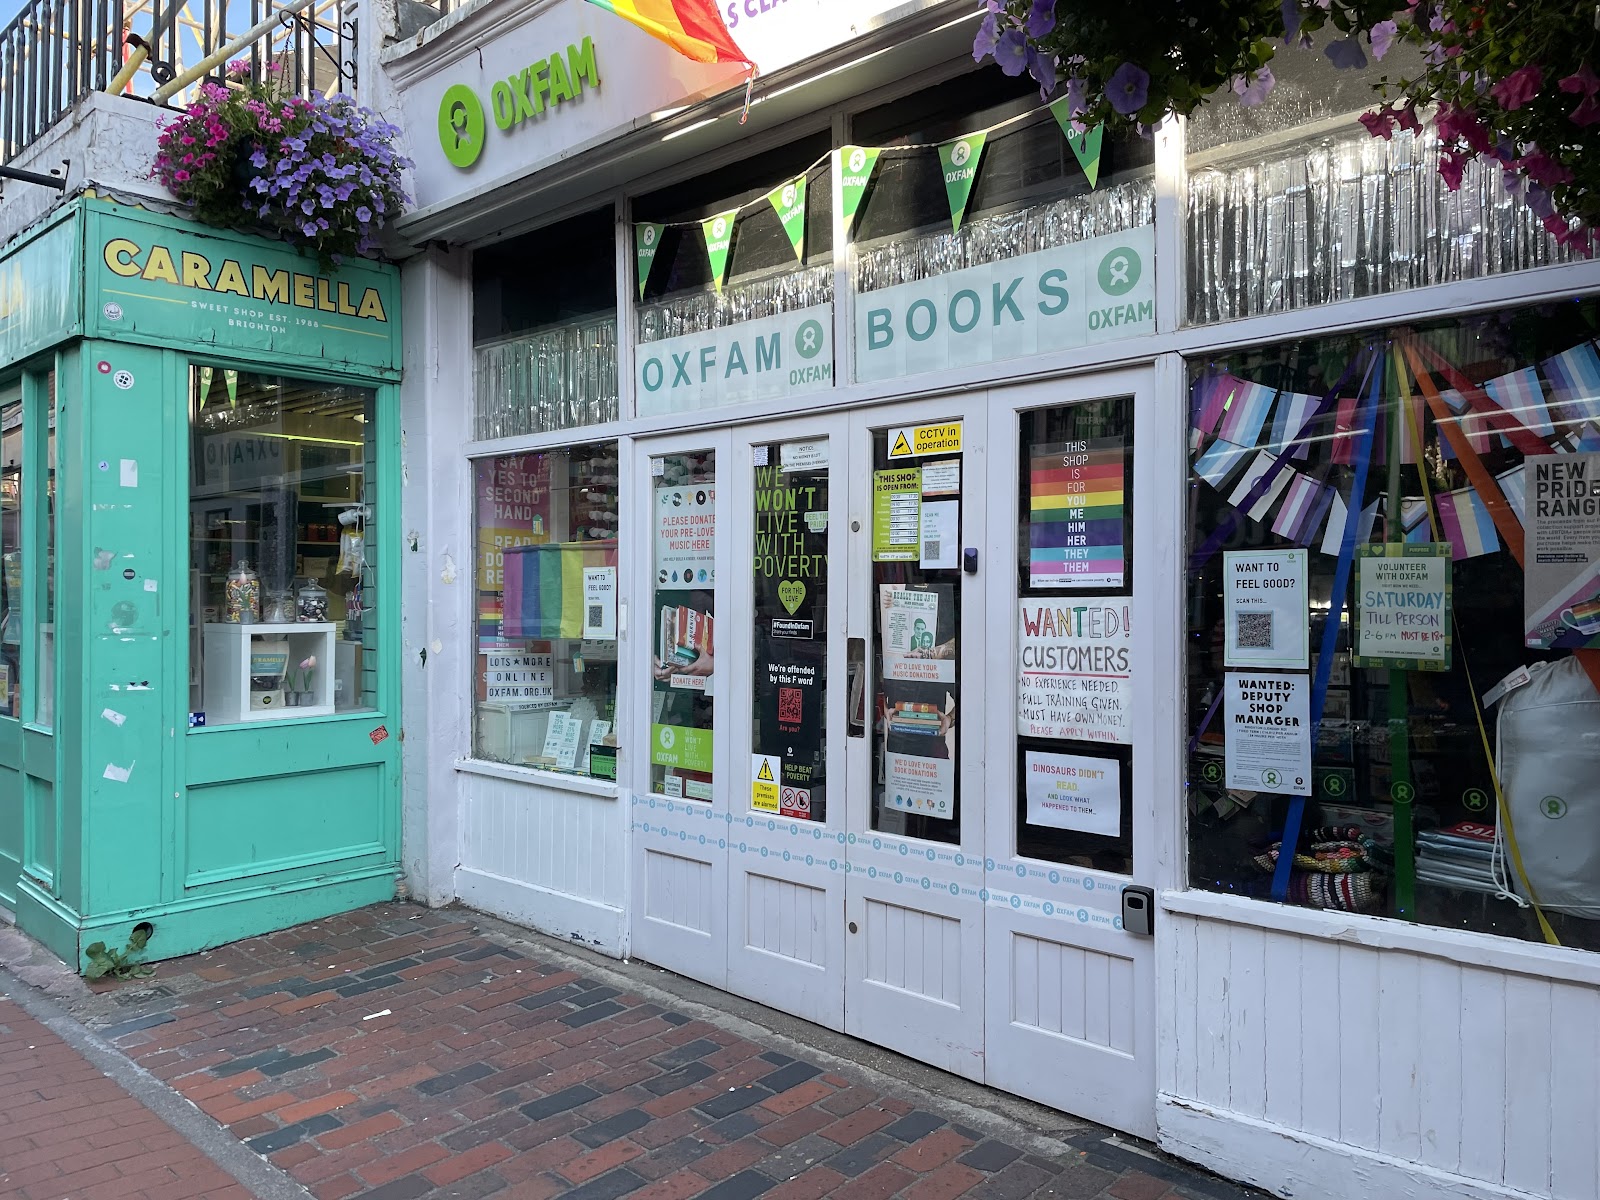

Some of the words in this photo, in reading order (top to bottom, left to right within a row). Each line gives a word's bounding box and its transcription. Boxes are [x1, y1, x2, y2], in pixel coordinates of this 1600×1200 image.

[491, 36, 598, 131] OXFAM
[945, 166, 975, 184] OXFAM
[842, 174, 867, 188] OXFAM
[781, 202, 804, 225] OXFAM
[708, 239, 730, 253] OXFAM
[638, 248, 656, 258] OXFAM
[103, 237, 388, 323] CARAMELLA
[191, 300, 229, 313] SWEET
[233, 307, 264, 319] SHOP
[269, 313, 291, 323] EST.
[295, 317, 319, 328] 1988
[867, 268, 1070, 352] BOOKS
[1088, 299, 1153, 332] OXFAM
[228, 318, 286, 334] BRIGHTON
[641, 331, 782, 393] OXFAM
[788, 362, 832, 387] OXFAM
[919, 428, 945, 439] CCTV
[947, 427, 956, 437] in
[916, 438, 959, 452] operation
[1065, 440, 1087, 453] THIS
[499, 456, 526, 470] SAY
[1063, 454, 1089, 467] SHOP
[756, 465, 785, 488] WE
[1071, 469, 1080, 479] IS
[1536, 462, 1586, 481] NEW
[488, 469, 516, 486] YES
[521, 472, 538, 488] TO
[879, 474, 896, 483] THIS
[896, 472, 916, 482] SHOP
[899, 482, 919, 490] FROM:
[1067, 482, 1086, 493] FOR
[485, 486, 540, 505] SECOND
[755, 487, 816, 512] WON'T
[1067, 495, 1087, 506] YOU
[494, 504, 532, 521] HAND
[1069, 508, 1084, 519] ME
[1536, 499, 1600, 517] RANG
[663, 516, 689, 526] PLEASE
[690, 514, 715, 525] DONATE
[805, 512, 819, 521] FEEL
[756, 511, 799, 534] LIVE
[809, 520, 827, 528] PRIDE
[1067, 522, 1086, 533] HIM
[660, 528, 679, 538] YOUR
[680, 527, 715, 537] PRE-LOVE
[669, 540, 690, 550] MUSIC
[692, 540, 710, 549] HERE
[755, 532, 805, 556] WITH
[1067, 535, 1087, 546] HER
[1064, 548, 1089, 559] THEY
[1063, 562, 1089, 572] THEM
[1235, 562, 1264, 573] WANT
[1267, 562, 1279, 572] TO
[1377, 563, 1427, 571] VOLUNTEER
[1375, 572, 1397, 580] WITH
[1399, 572, 1429, 580] OXFAM
[1236, 579, 1260, 589] FEEL
[1263, 578, 1296, 589] GOOD?
[781, 586, 791, 594] FOR
[792, 586, 803, 595] THE
[785, 594, 799, 603] LOVE
[1365, 590, 1444, 610] SATURDAY
[1022, 606, 1131, 639] WANTED!
[1366, 611, 1391, 625] TILL
[1395, 611, 1440, 627] PERSON
[1364, 630, 1383, 640] 2-6
[1401, 631, 1420, 641] MUST
[1421, 632, 1429, 641] BE
[1431, 631, 1445, 641] 18+
[489, 657, 511, 667] LOTS
[522, 657, 551, 667] MORE
[1022, 645, 1132, 673] CUSTOMERS.
[768, 663, 786, 674] We're
[787, 664, 815, 676] offended
[894, 662, 907, 670] WE'D
[908, 663, 921, 671] LOVE
[496, 672, 545, 682] ONLINE
[769, 674, 778, 684] by
[778, 674, 791, 684] this
[792, 675, 797, 684] F
[797, 675, 814, 685] word
[892, 670, 908, 678] MUSIC
[909, 671, 939, 679] DONATIONS
[672, 677, 691, 685] DONATE
[692, 678, 704, 686] HERE
[1021, 676, 1031, 687] NO
[1035, 676, 1077, 691] EXPERIENCE
[1081, 679, 1120, 693] NEEDED.
[1238, 679, 1295, 691] WANTED:
[489, 687, 552, 697] OXFAM.ORG.UK
[1241, 691, 1291, 702] DEPUTY
[1022, 693, 1043, 706] FULL
[1046, 693, 1088, 710] TRAINING
[1091, 696, 1122, 711] GIVEN.
[1249, 703, 1283, 714] SHOP
[1023, 708, 1046, 721] MUST
[1050, 710, 1071, 723] HAVE
[1074, 712, 1095, 724] OWN
[1235, 714, 1300, 727] MANAGER
[684, 728, 694, 737] WE
[779, 724, 788, 732] Are
[788, 725, 800, 734] you?
[1030, 723, 1053, 736] PLEASE
[1059, 727, 1083, 737] APPLY
[684, 735, 702, 745] WON'T
[684, 743, 697, 752] LIVE
[656, 751, 679, 764] OXFAM
[684, 751, 699, 759] WITH
[684, 758, 707, 768] POVERTY
[784, 763, 798, 773] HELP
[798, 764, 813, 774] BEAT
[922, 762, 937, 770] YOUR
[786, 772, 811, 782] POVERTY
[894, 766, 907, 774] BOOK
[908, 768, 938, 778] DONATIONS
[1032, 763, 1077, 776] DINOSAURS
[1078, 768, 1105, 780] DIDN'T
[1056, 780, 1080, 791] READ.
[756, 792, 775, 800] premises
[1074, 796, 1090, 804] WHAT
[761, 801, 778, 809] alarmed
[1041, 801, 1070, 811] HAPPENED
[1456, 825, 1495, 838] SAL
[1062, 875, 1081, 885] OXFAM
[1097, 881, 1116, 892] OXFAM
[1091, 914, 1110, 925] OXFAM
